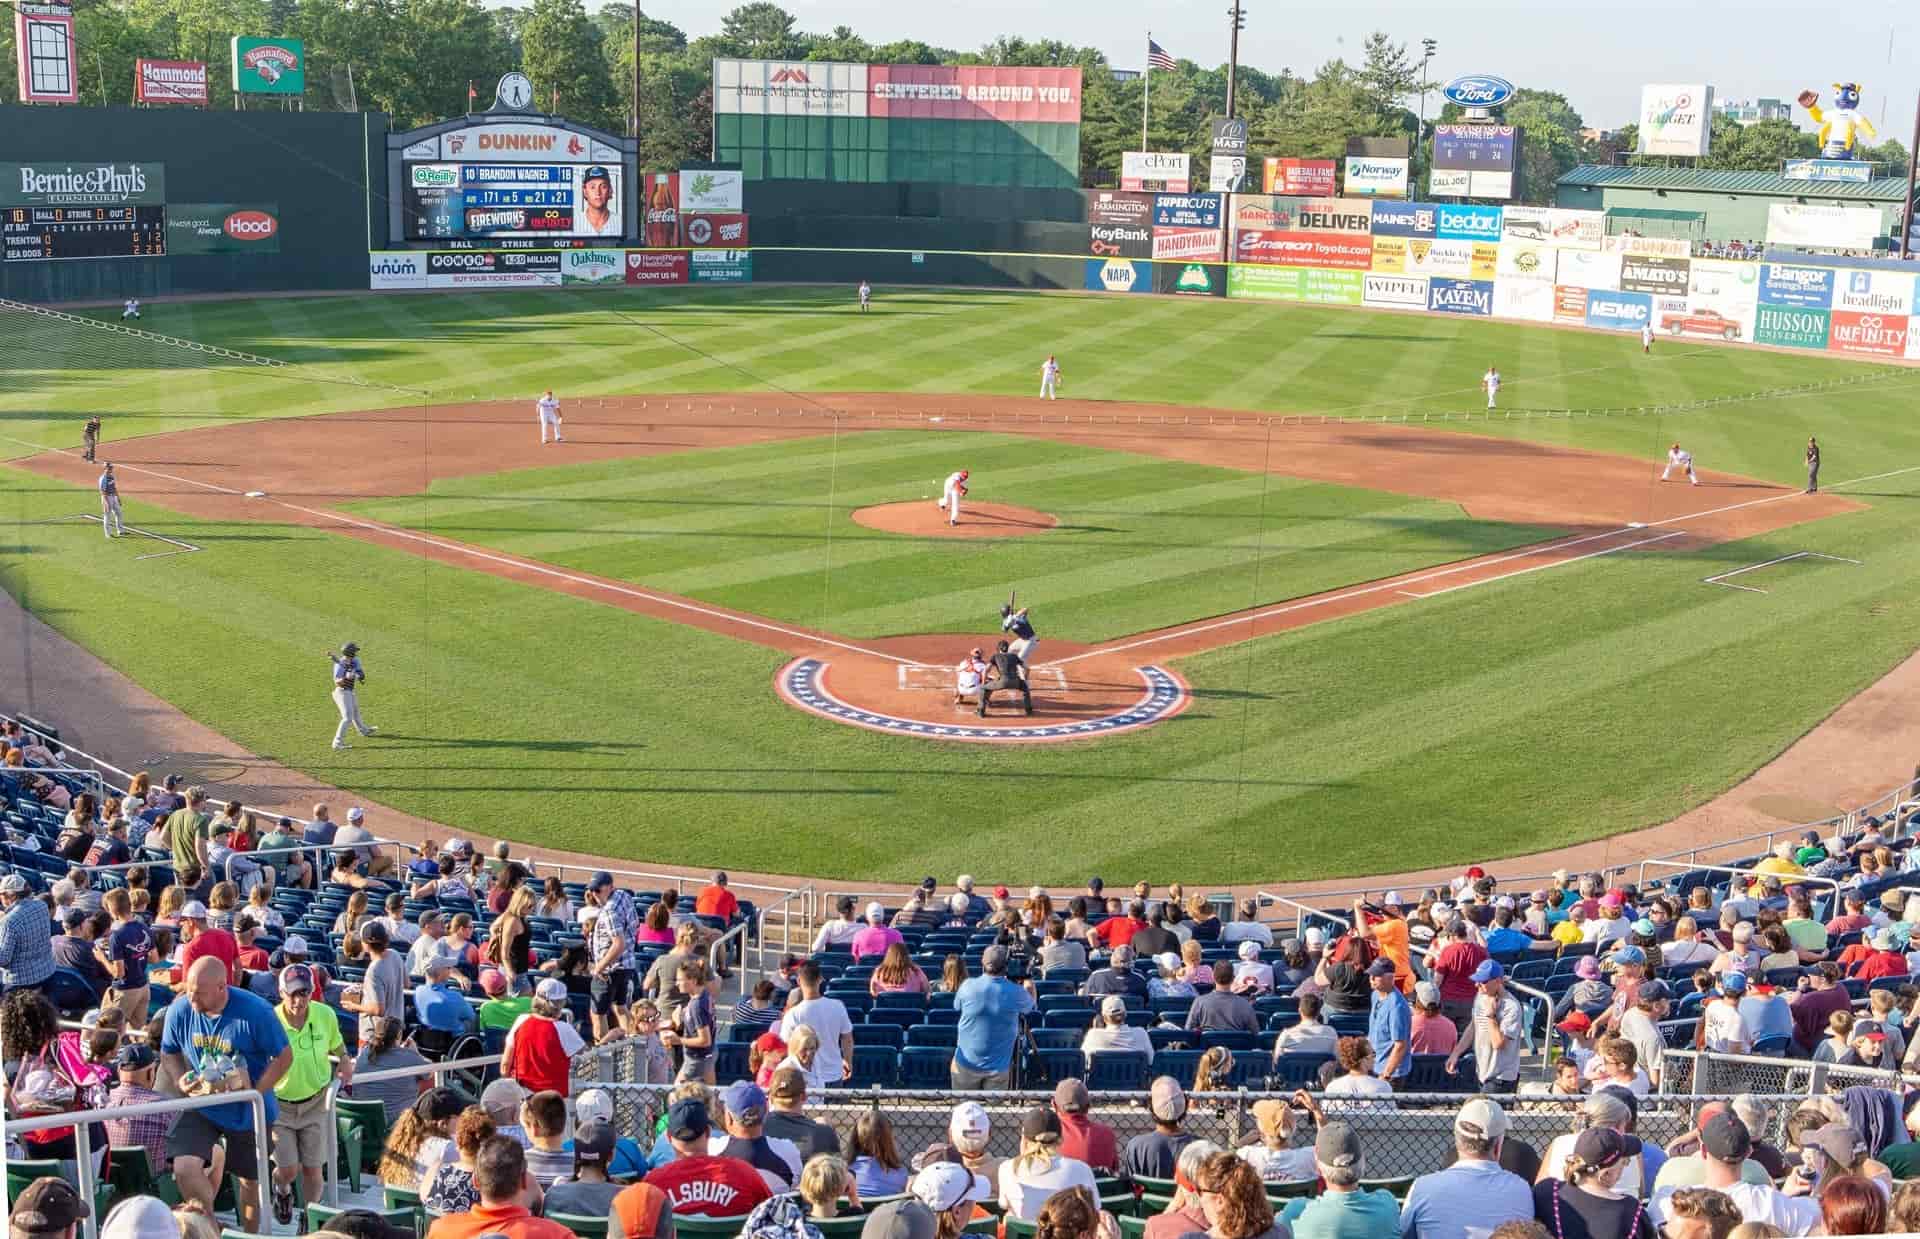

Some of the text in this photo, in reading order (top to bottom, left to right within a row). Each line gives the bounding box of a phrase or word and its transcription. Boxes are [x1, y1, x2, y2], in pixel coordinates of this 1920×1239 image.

[250, 49, 293, 63] Hannaford
[143, 63, 205, 81] Hammond
[173, 85, 205, 96] Company
[737, 85, 845, 98] Maine Medical Center
[874, 83, 1074, 103] CENTERED AROUND YOU.
[1456, 82, 1496, 101] Ford
[478, 134, 556, 151] DUNKIN'
[1214, 137, 1243, 149] MAST
[465, 168, 476, 180] 10
[479, 168, 517, 180] BRANDON
[518, 169, 549, 181] WAGNER
[1286, 167, 1316, 176] BASEBALL
[1361, 163, 1402, 177] Norway
[480, 191, 499, 203] .171
[535, 192, 545, 203] 21
[556, 192, 567, 203] 21
[1157, 197, 1216, 209] SUPERCUTS
[1094, 200, 1149, 212] FARMINGTON
[13, 208, 24, 223] 10
[36, 210, 54, 220] BALL
[55, 208, 63, 221] 0
[67, 209, 92, 219] STRIKE
[110, 209, 124, 218] OUT
[470, 210, 526, 229] FIREWORKS
[1239, 210, 1289, 221] HANCOCK
[1373, 213, 1415, 226] MAINE'S
[1440, 209, 1501, 231] bedard
[4, 224, 30, 232] AT BAT
[230, 217, 271, 233] Hood
[1299, 212, 1369, 230] DELIVER
[5, 236, 41, 245] TRENTON
[1091, 226, 1149, 242] KeyBank
[1157, 232, 1217, 252] HANDYMAN
[1239, 232, 1313, 251] Emerson
[1315, 245, 1371, 257] Toyota.com
[7, 248, 42, 258] SEA DOGS
[527, 255, 559, 265] MILLION
[571, 250, 616, 267] Oakhurst
[371, 262, 416, 275] unum
[1106, 267, 1131, 281] NAPA
[1622, 264, 1688, 283] AMATO'S
[1769, 265, 1827, 285] Bangor
[637, 272, 660, 280] COUNT
[1766, 280, 1827, 293] Savings Bank
[1431, 287, 1490, 314] KAYEM
[1843, 291, 1902, 311] headlight
[1591, 301, 1647, 320] MEMIC
[1760, 310, 1825, 334] HUSSON
[1760, 330, 1824, 344] UNIVERSITY
[1834, 325, 1906, 347] INFINITY
[667, 1180, 739, 1208] LSBURY
